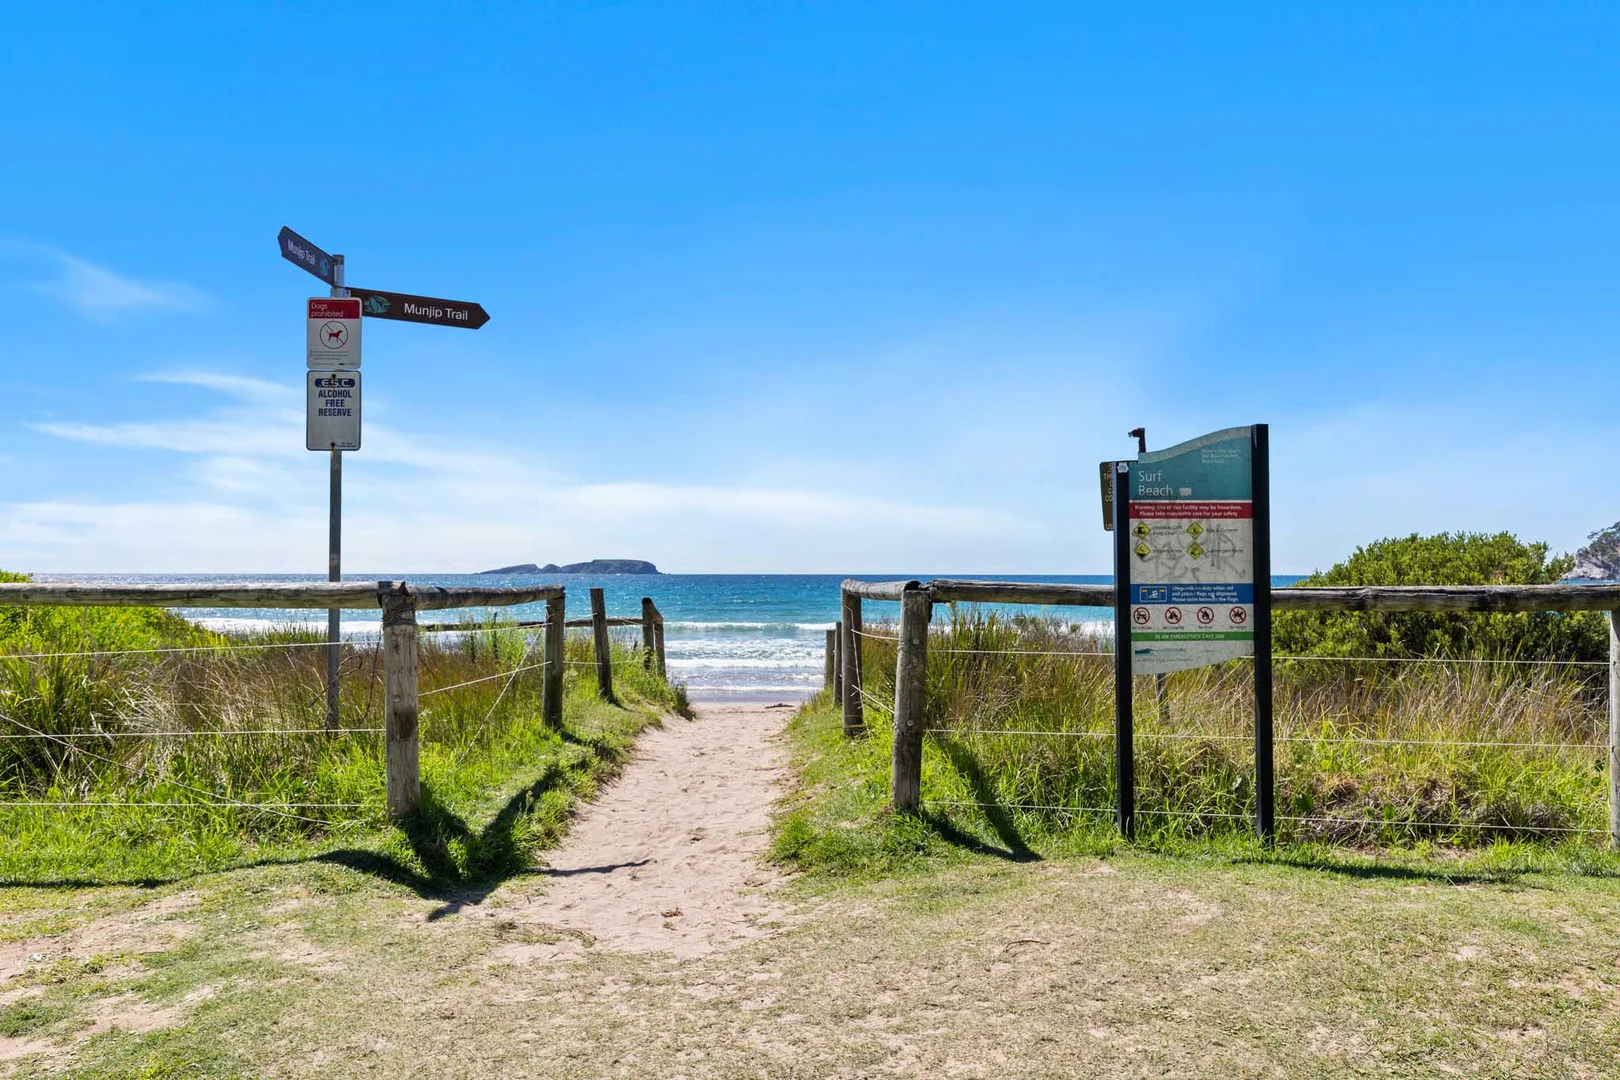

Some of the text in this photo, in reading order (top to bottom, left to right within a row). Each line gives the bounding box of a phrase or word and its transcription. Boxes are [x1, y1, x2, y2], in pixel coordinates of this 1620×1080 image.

[288, 238, 316, 266] Munjip Trail
[311, 302, 328, 310] Dogs
[404, 302, 468, 320] Munjip Trail
[318, 390, 352, 398] ALCOHOL
[325, 399, 345, 407] FREE
[318, 408, 352, 416] RESERVE
[1138, 470, 1162, 482] Surf
[1138, 484, 1173, 496] Beach
